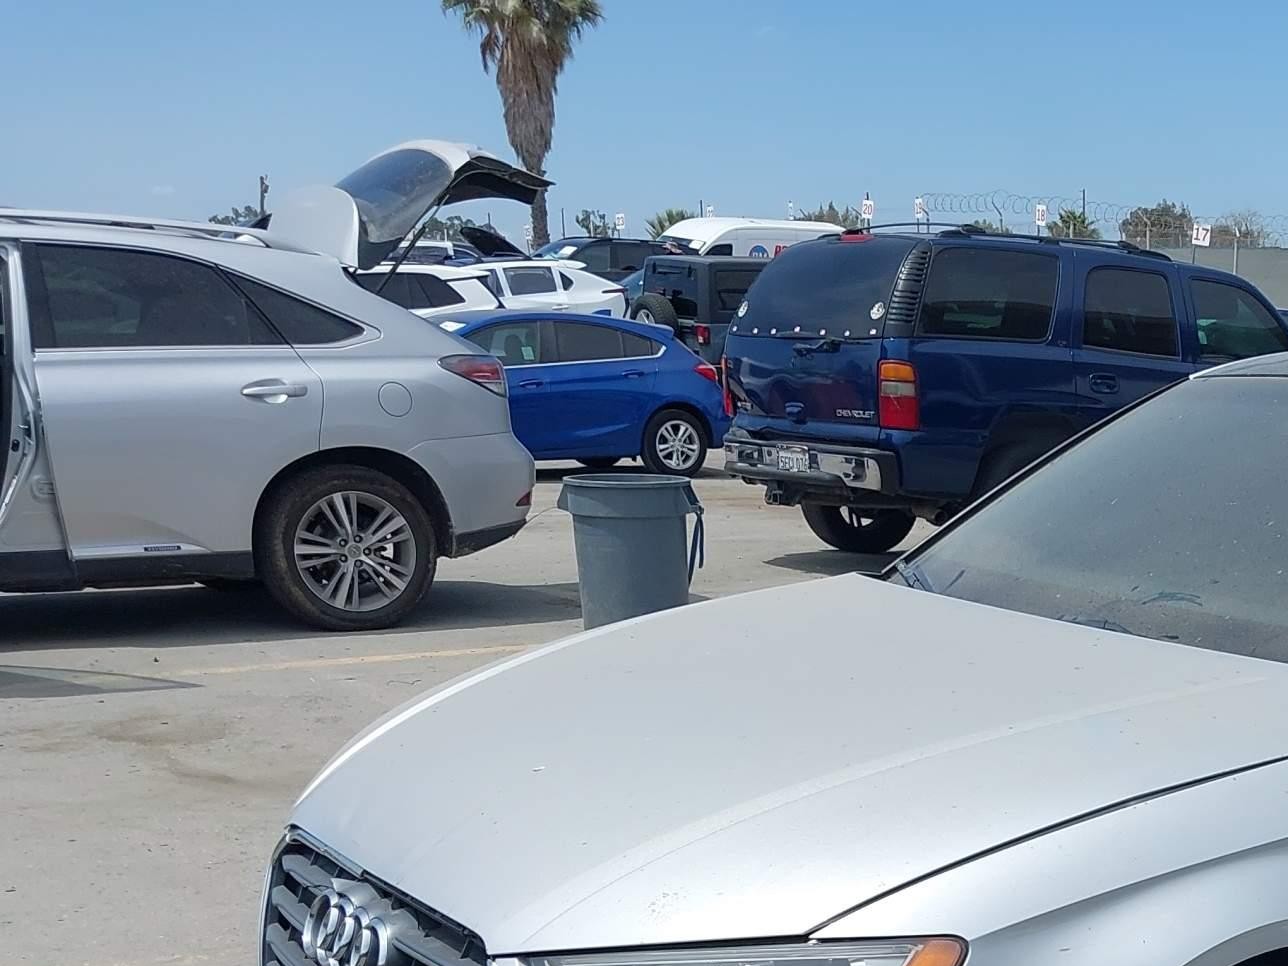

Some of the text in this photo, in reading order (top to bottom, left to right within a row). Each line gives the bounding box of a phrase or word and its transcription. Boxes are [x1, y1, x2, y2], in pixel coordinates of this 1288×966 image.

[863, 203, 873, 215] 20
[1037, 208, 1046, 222] 18
[1193, 227, 1210, 242] 17
[836, 409, 876, 418] CHEVROLET
